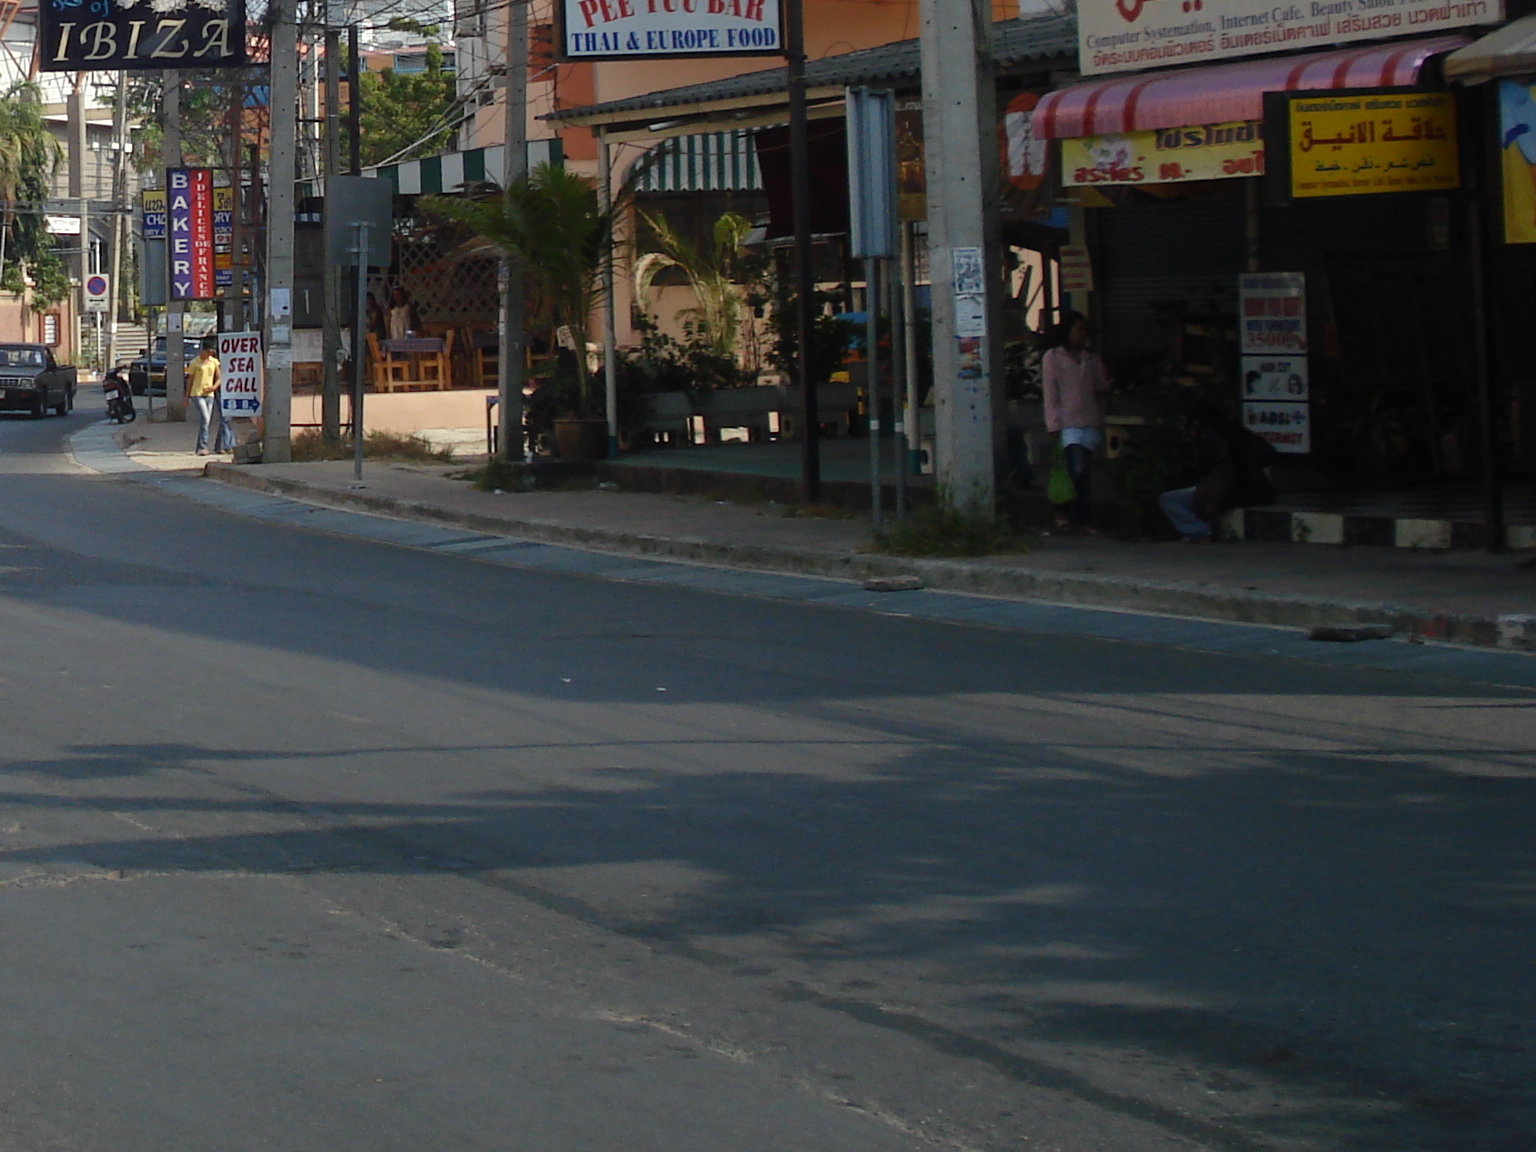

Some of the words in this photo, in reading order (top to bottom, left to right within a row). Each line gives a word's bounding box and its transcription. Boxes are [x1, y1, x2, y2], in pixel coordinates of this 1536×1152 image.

[1087, 29, 1139, 50] Computer
[1221, 7, 1269, 29] Internet
[1311, 0, 1354, 19] Beauty
[52, 18, 234, 62] IBIZA
[571, 32, 619, 52] THAI
[626, 31, 640, 51] &
[647, 29, 720, 50] EUROPE
[727, 27, 776, 47] FOOD
[172, 174, 191, 297] BAKERY
[221, 338, 258, 354] OVER
[228, 357, 254, 373] SEA
[226, 377, 257, 393] CALL
